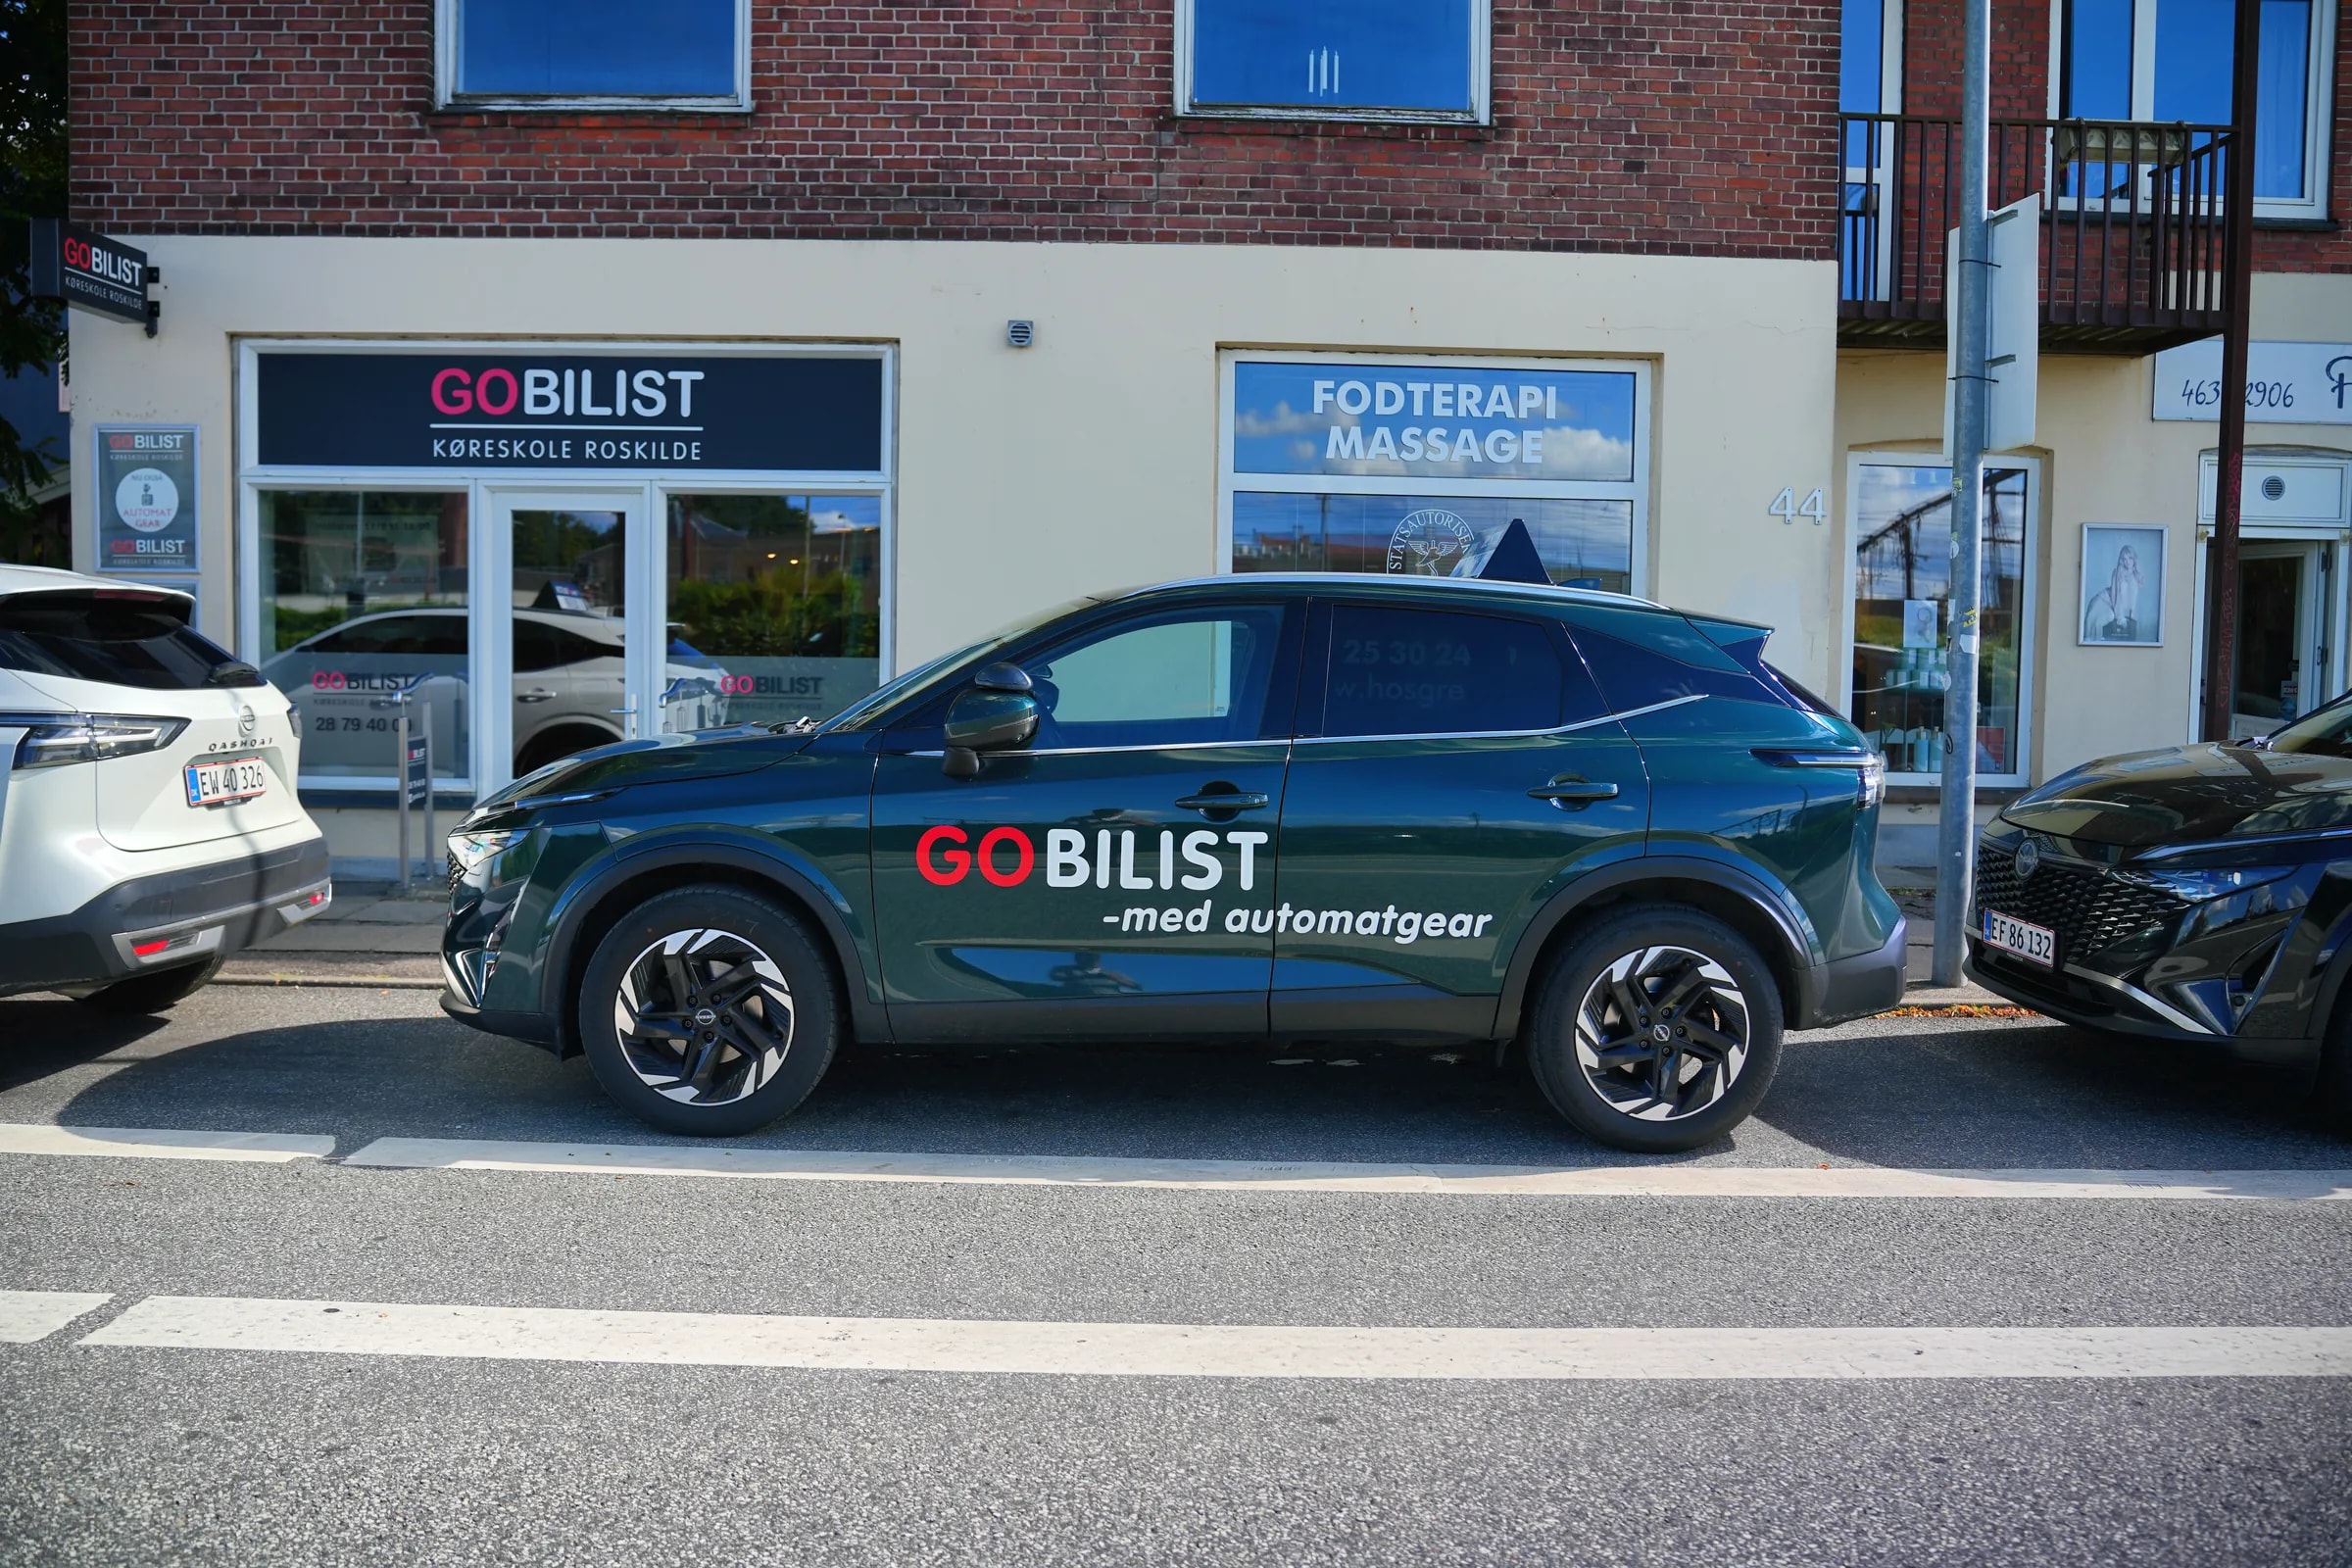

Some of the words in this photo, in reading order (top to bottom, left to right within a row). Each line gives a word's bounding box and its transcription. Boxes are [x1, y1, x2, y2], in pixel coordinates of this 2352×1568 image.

[64, 237, 142, 286] GOBILIST
[109, 290, 142, 310] ROSKILDE
[431, 368, 705, 417] GOBILIST
[1313, 379, 1556, 419] FODTERAPI
[109, 434, 183, 449] GOBILIST
[433, 439, 571, 459] KØRESKOLE
[585, 440, 702, 461] ROSKILDE
[1325, 425, 1543, 464] MASSAGE
[123, 508, 172, 517] AUTOMAT
[1769, 487, 1827, 525] 44
[135, 518, 160, 528] GEAR
[111, 539, 185, 554] GOBILIST
[1389, 640, 1426, 665] 30
[313, 671, 414, 691] GOBILIST
[721, 675, 824, 695] GOBILIST
[316, 717, 335, 731] 28
[342, 717, 361, 731] 79
[366, 717, 387, 731] 40
[208, 737, 272, 752] QASHQAI
[200, 770, 220, 796] EW
[223, 767, 238, 793] 40
[240, 764, 264, 790] 326
[915, 825, 1269, 891] GOBILIST
[1103, 900, 1212, 933] -med
[1225, 903, 1493, 944] automatgear
[1991, 917, 2006, 942] EF
[2009, 923, 2025, 950] 86
[2028, 930, 2051, 959] 132
